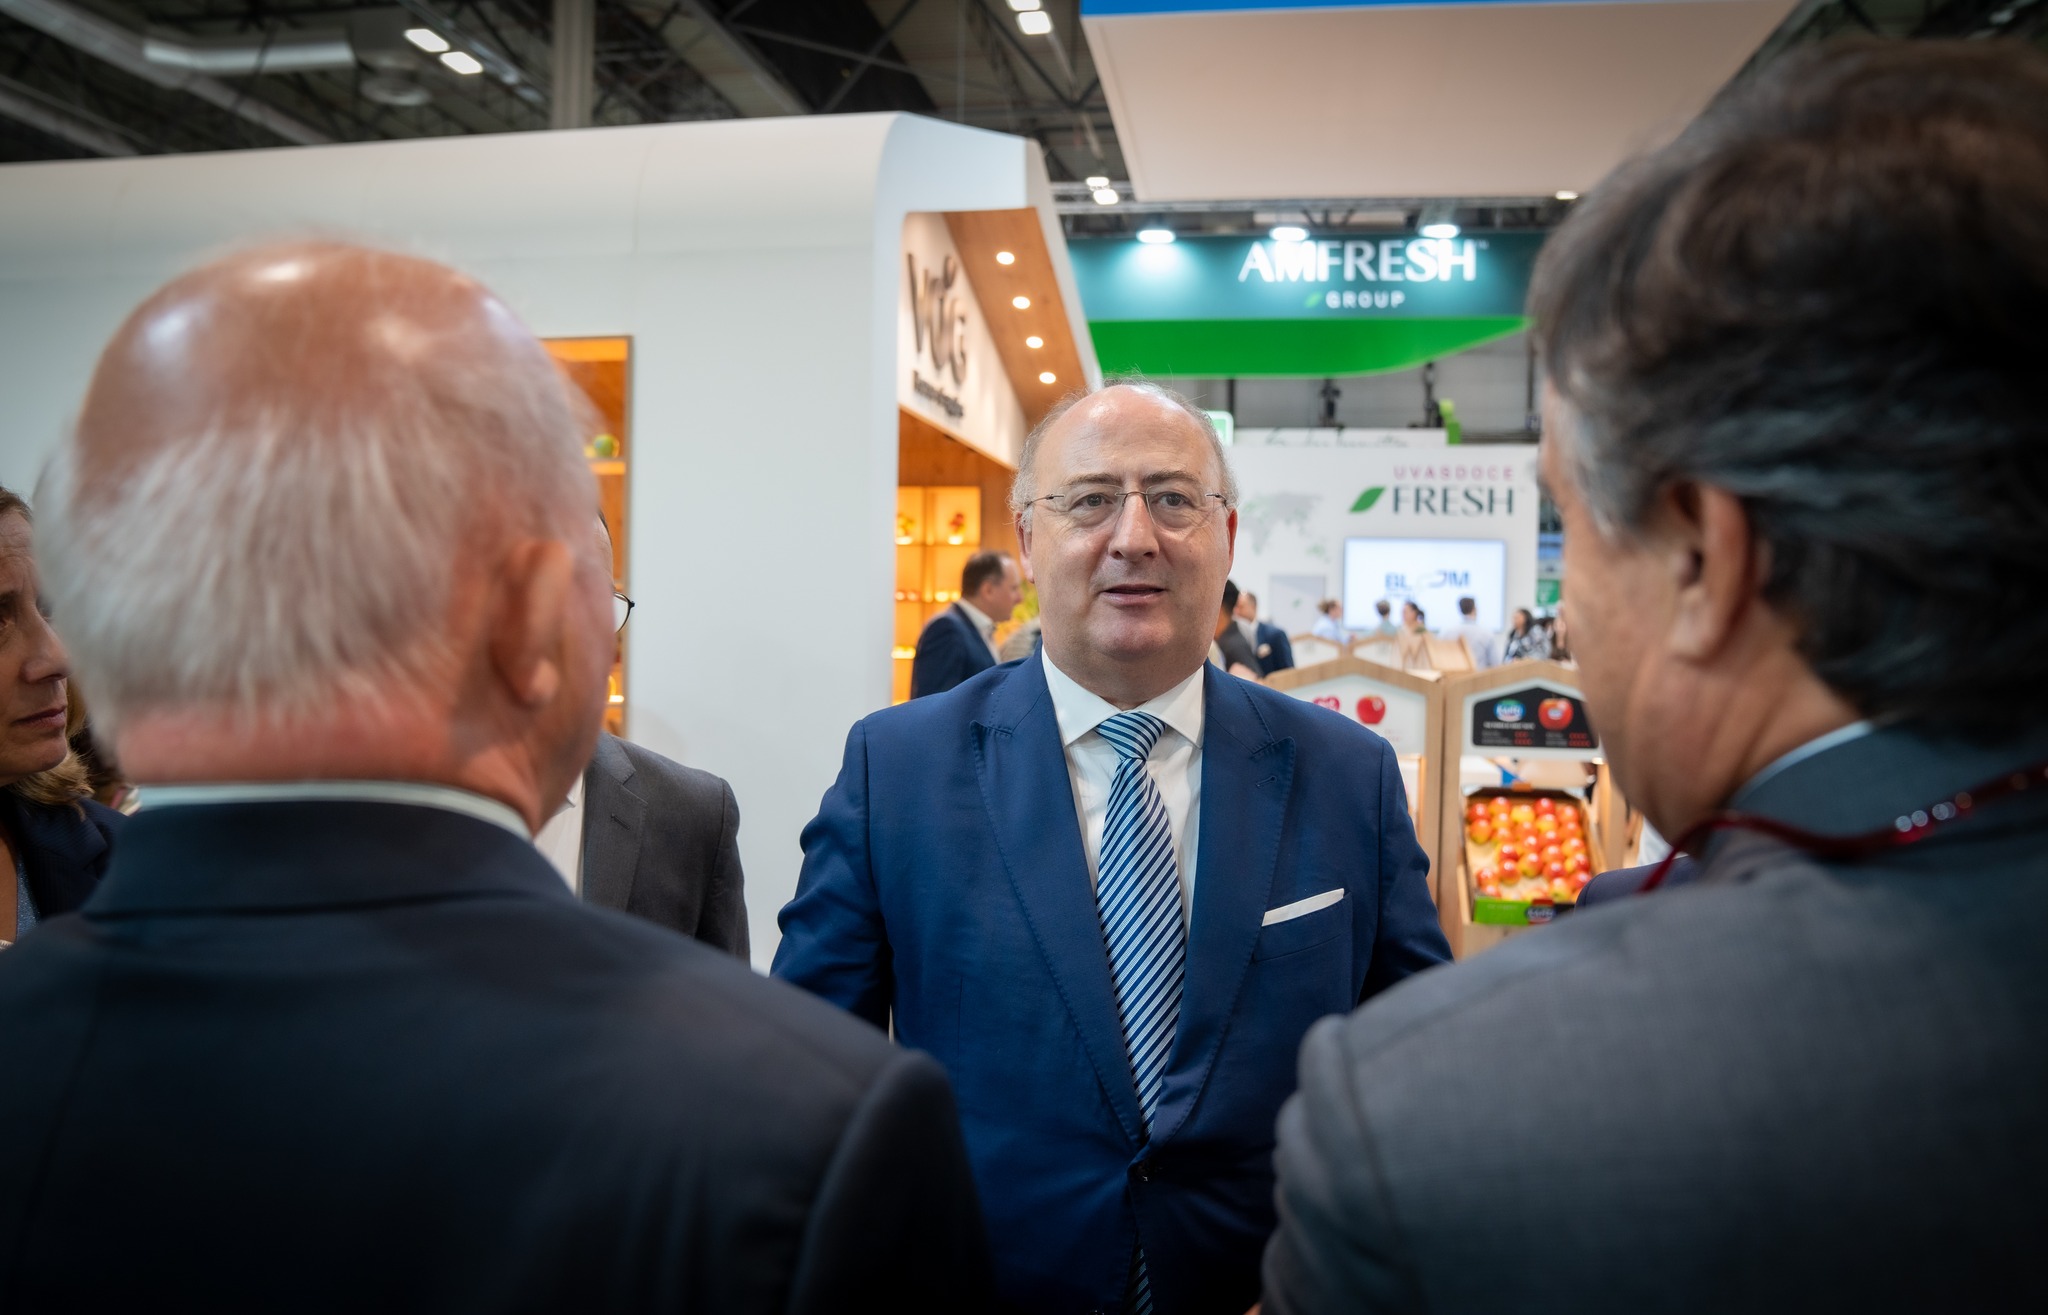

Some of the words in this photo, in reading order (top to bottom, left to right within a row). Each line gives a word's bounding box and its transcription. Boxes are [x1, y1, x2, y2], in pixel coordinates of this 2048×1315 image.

[1238, 239, 1476, 282] AMFRESH
[1325, 291, 1405, 309] GROUP
[1393, 465, 1513, 480] UVASDOCE
[1394, 487, 1513, 515] FRESH
